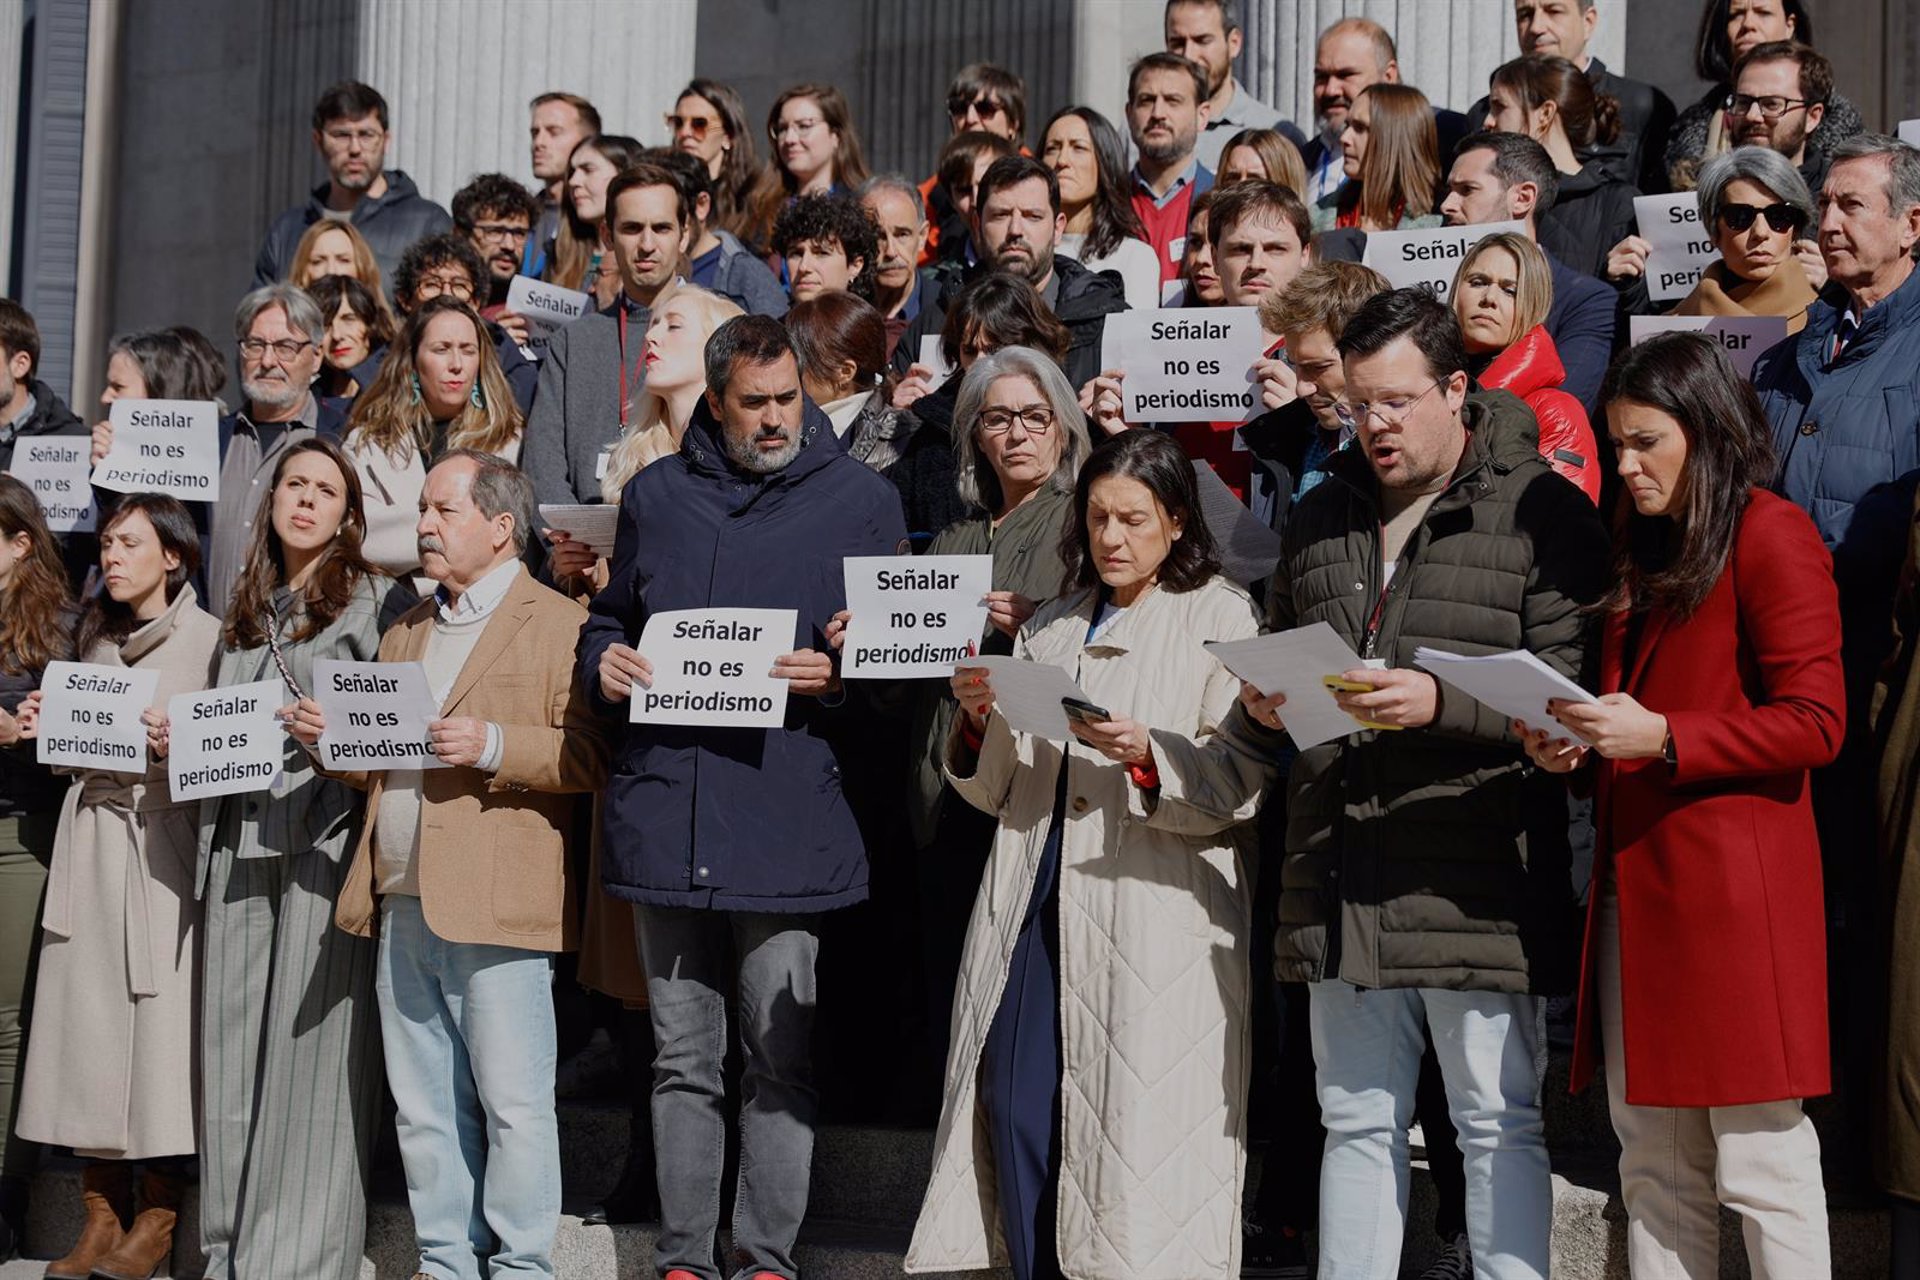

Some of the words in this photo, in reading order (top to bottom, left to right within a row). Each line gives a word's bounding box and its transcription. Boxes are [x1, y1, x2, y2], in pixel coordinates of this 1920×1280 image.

[1402, 238, 1476, 261] Señal
[1687, 240, 1714, 254] no
[527, 290, 579, 316] Señalar
[1151, 320, 1231, 340] Señalar
[1164, 361, 1189, 375] no
[1197, 360, 1220, 374] es
[1135, 389, 1254, 413] periodismo
[131, 411, 193, 427] Señalar
[29, 447, 78, 462] Señalar
[141, 445, 160, 457] no
[167, 446, 184, 457] es
[34, 478, 52, 491] no
[55, 480, 70, 491] es
[107, 469, 209, 489] periodismo
[41, 503, 89, 519] odismo
[877, 569, 959, 590] Señalar
[673, 620, 762, 641] Señalar
[891, 613, 916, 628] no
[923, 613, 946, 628] es
[855, 643, 968, 668] periodismo
[683, 661, 712, 676] no
[720, 662, 743, 677] es
[66, 674, 131, 694] Señalar
[333, 673, 398, 693] Señalar
[193, 697, 257, 720] Señalar
[645, 690, 772, 713] periodismo
[72, 710, 91, 723] no
[96, 712, 113, 725] es
[348, 712, 371, 726] no
[376, 713, 399, 726] es
[48, 736, 136, 758] periodismo
[202, 737, 222, 752] no
[229, 734, 247, 748] es
[330, 739, 436, 761] periodismo
[178, 761, 273, 790] periodismo
